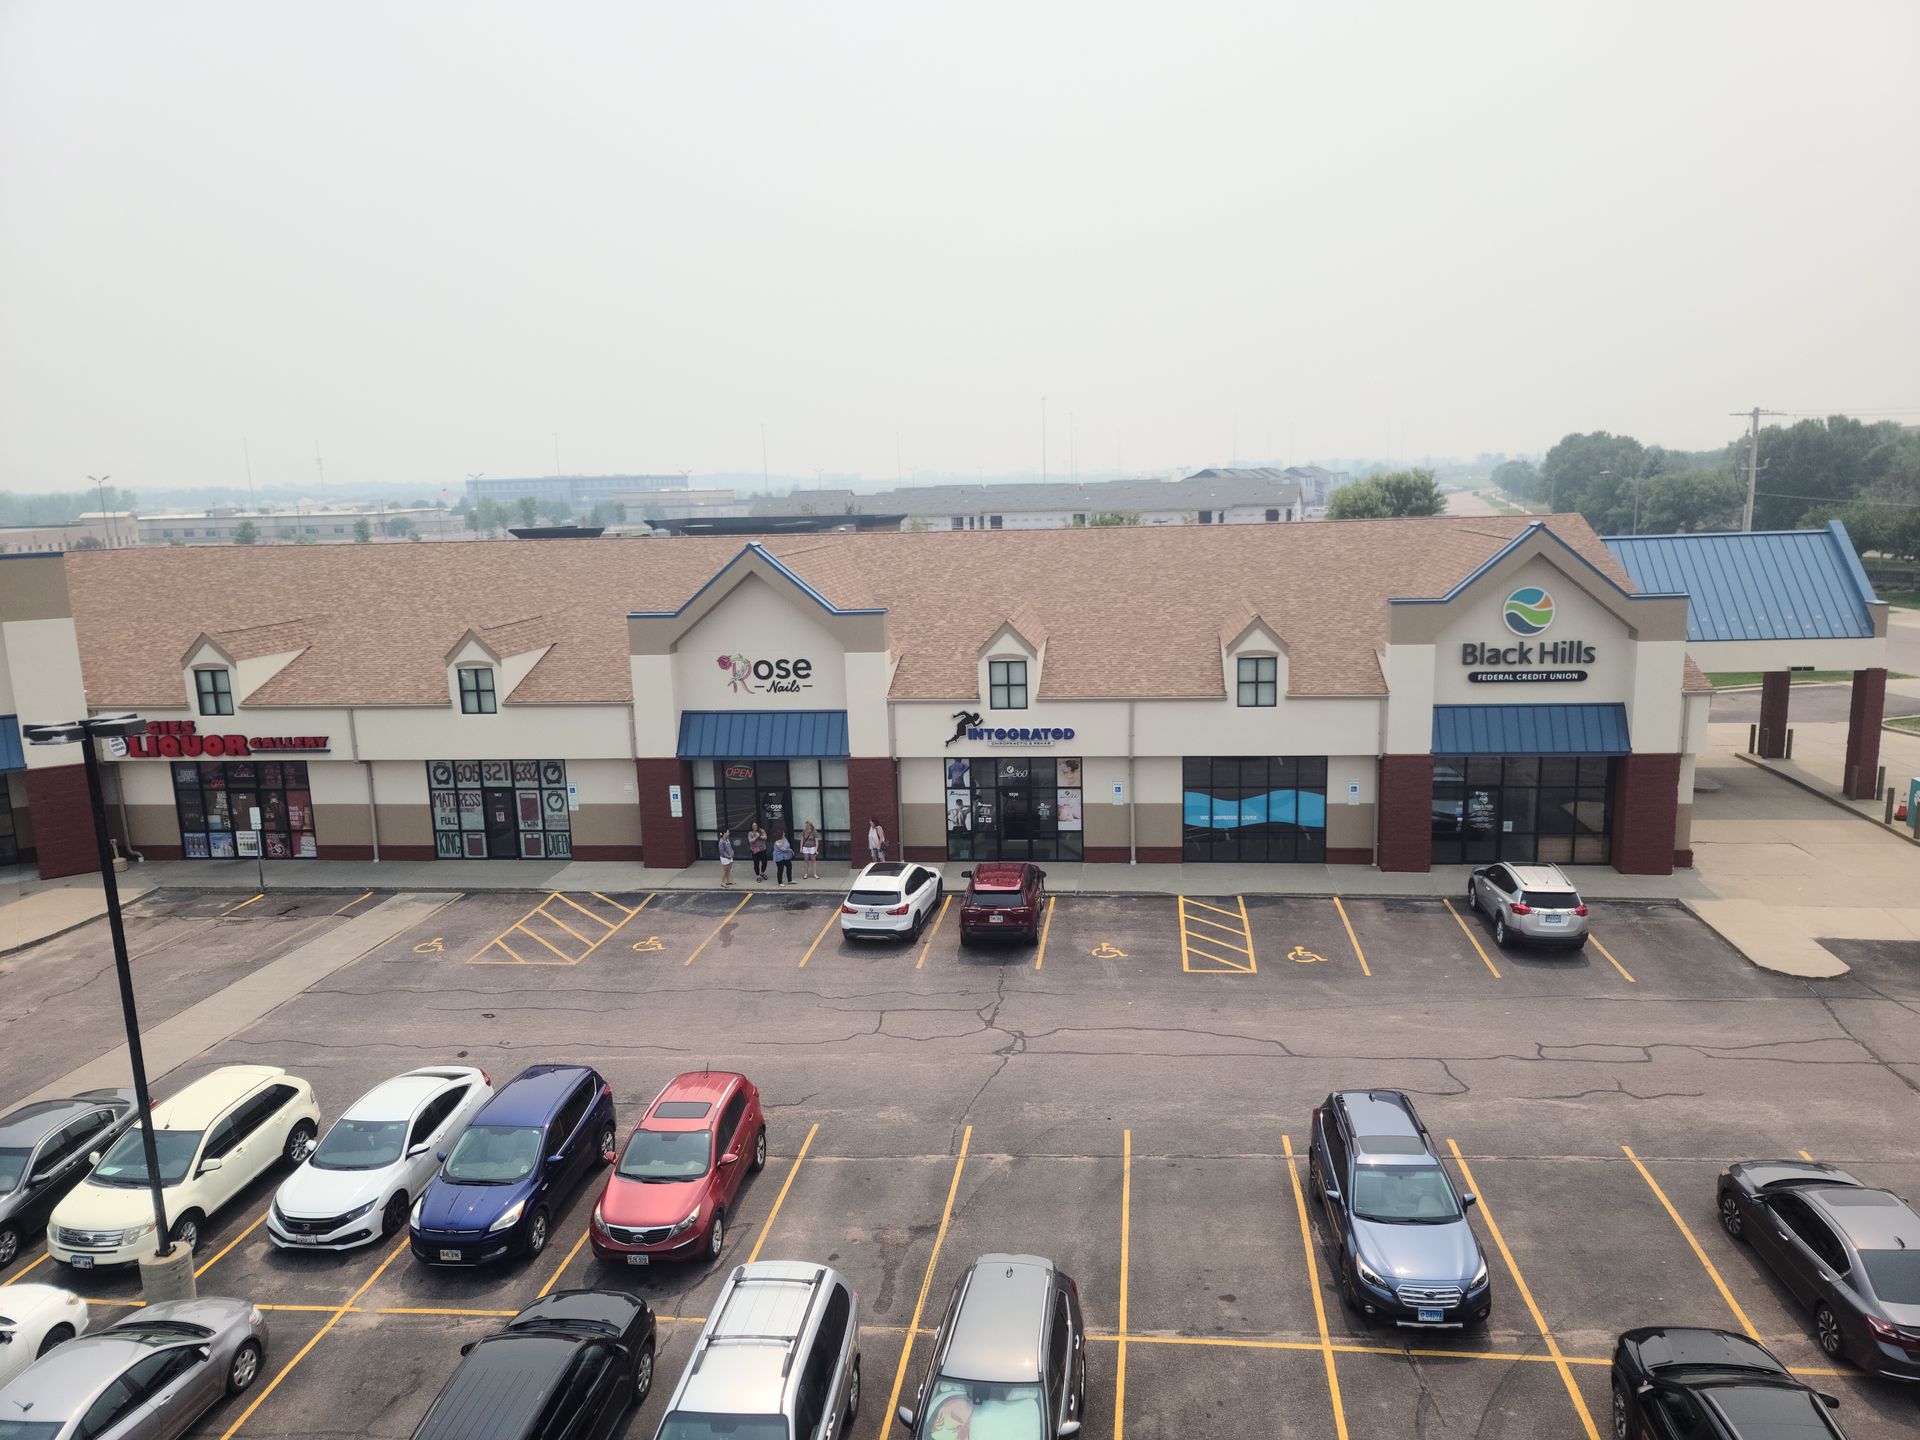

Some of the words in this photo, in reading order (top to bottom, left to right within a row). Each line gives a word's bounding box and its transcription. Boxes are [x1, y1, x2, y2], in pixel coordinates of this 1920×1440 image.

[1462, 641, 1533, 666] Black
[1539, 640, 1596, 664] Hills
[717, 654, 812, 694] Rose
[1478, 673, 1514, 681] FEDERAL
[1517, 672, 1547, 681] CREDIT
[1550, 671, 1578, 680] UNION
[767, 679, 801, 694] Nails
[146, 720, 196, 736] GIES
[129, 735, 251, 758] LIQUOR
[250, 737, 329, 750] GALLERY
[455, 764, 481, 783] 605
[484, 762, 510, 782] 321
[514, 762, 539, 782] 6332
[726, 768, 754, 779] OPEN
[433, 792, 481, 809] MATTRESS
[441, 816, 458, 825] FULL
[523, 820, 539, 828] TWIN
[439, 833, 461, 855] KING
[548, 833, 570, 855] QUEEN
